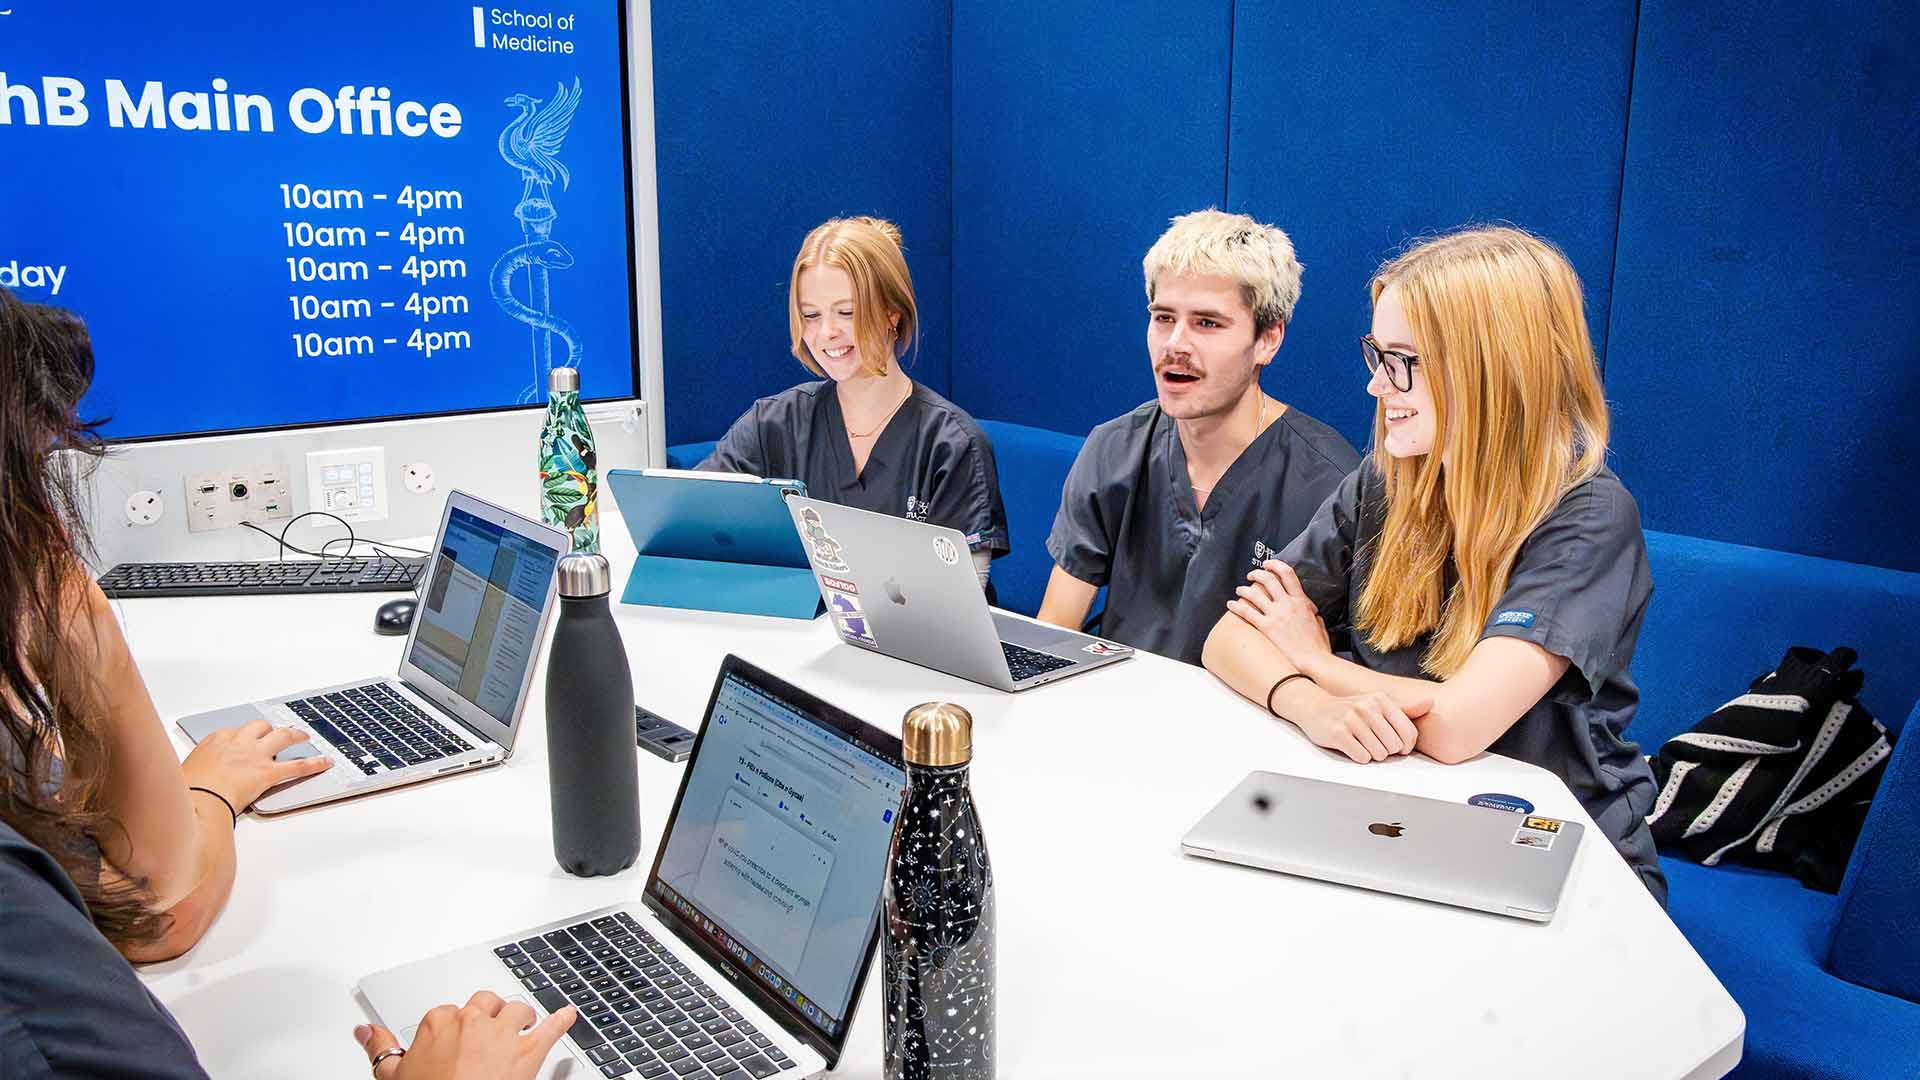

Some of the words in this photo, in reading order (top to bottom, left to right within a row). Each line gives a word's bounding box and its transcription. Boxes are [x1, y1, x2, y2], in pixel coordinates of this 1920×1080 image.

[491, 8, 553, 29] School
[557, 12, 575, 31] of
[492, 32, 575, 54] Medicine
[105, 78, 275, 132] Main
[288, 84, 463, 139] Office
[280, 183, 364, 209] 10am
[396, 185, 463, 217] 4pm
[283, 221, 366, 247] 10am
[399, 222, 465, 253] 4pm
[286, 256, 369, 282] 10am
[401, 255, 467, 286] 4pm
[289, 295, 371, 321] 10am
[404, 292, 469, 322] 4pm
[292, 332, 374, 358] 10am
[406, 328, 471, 358] 4pm
